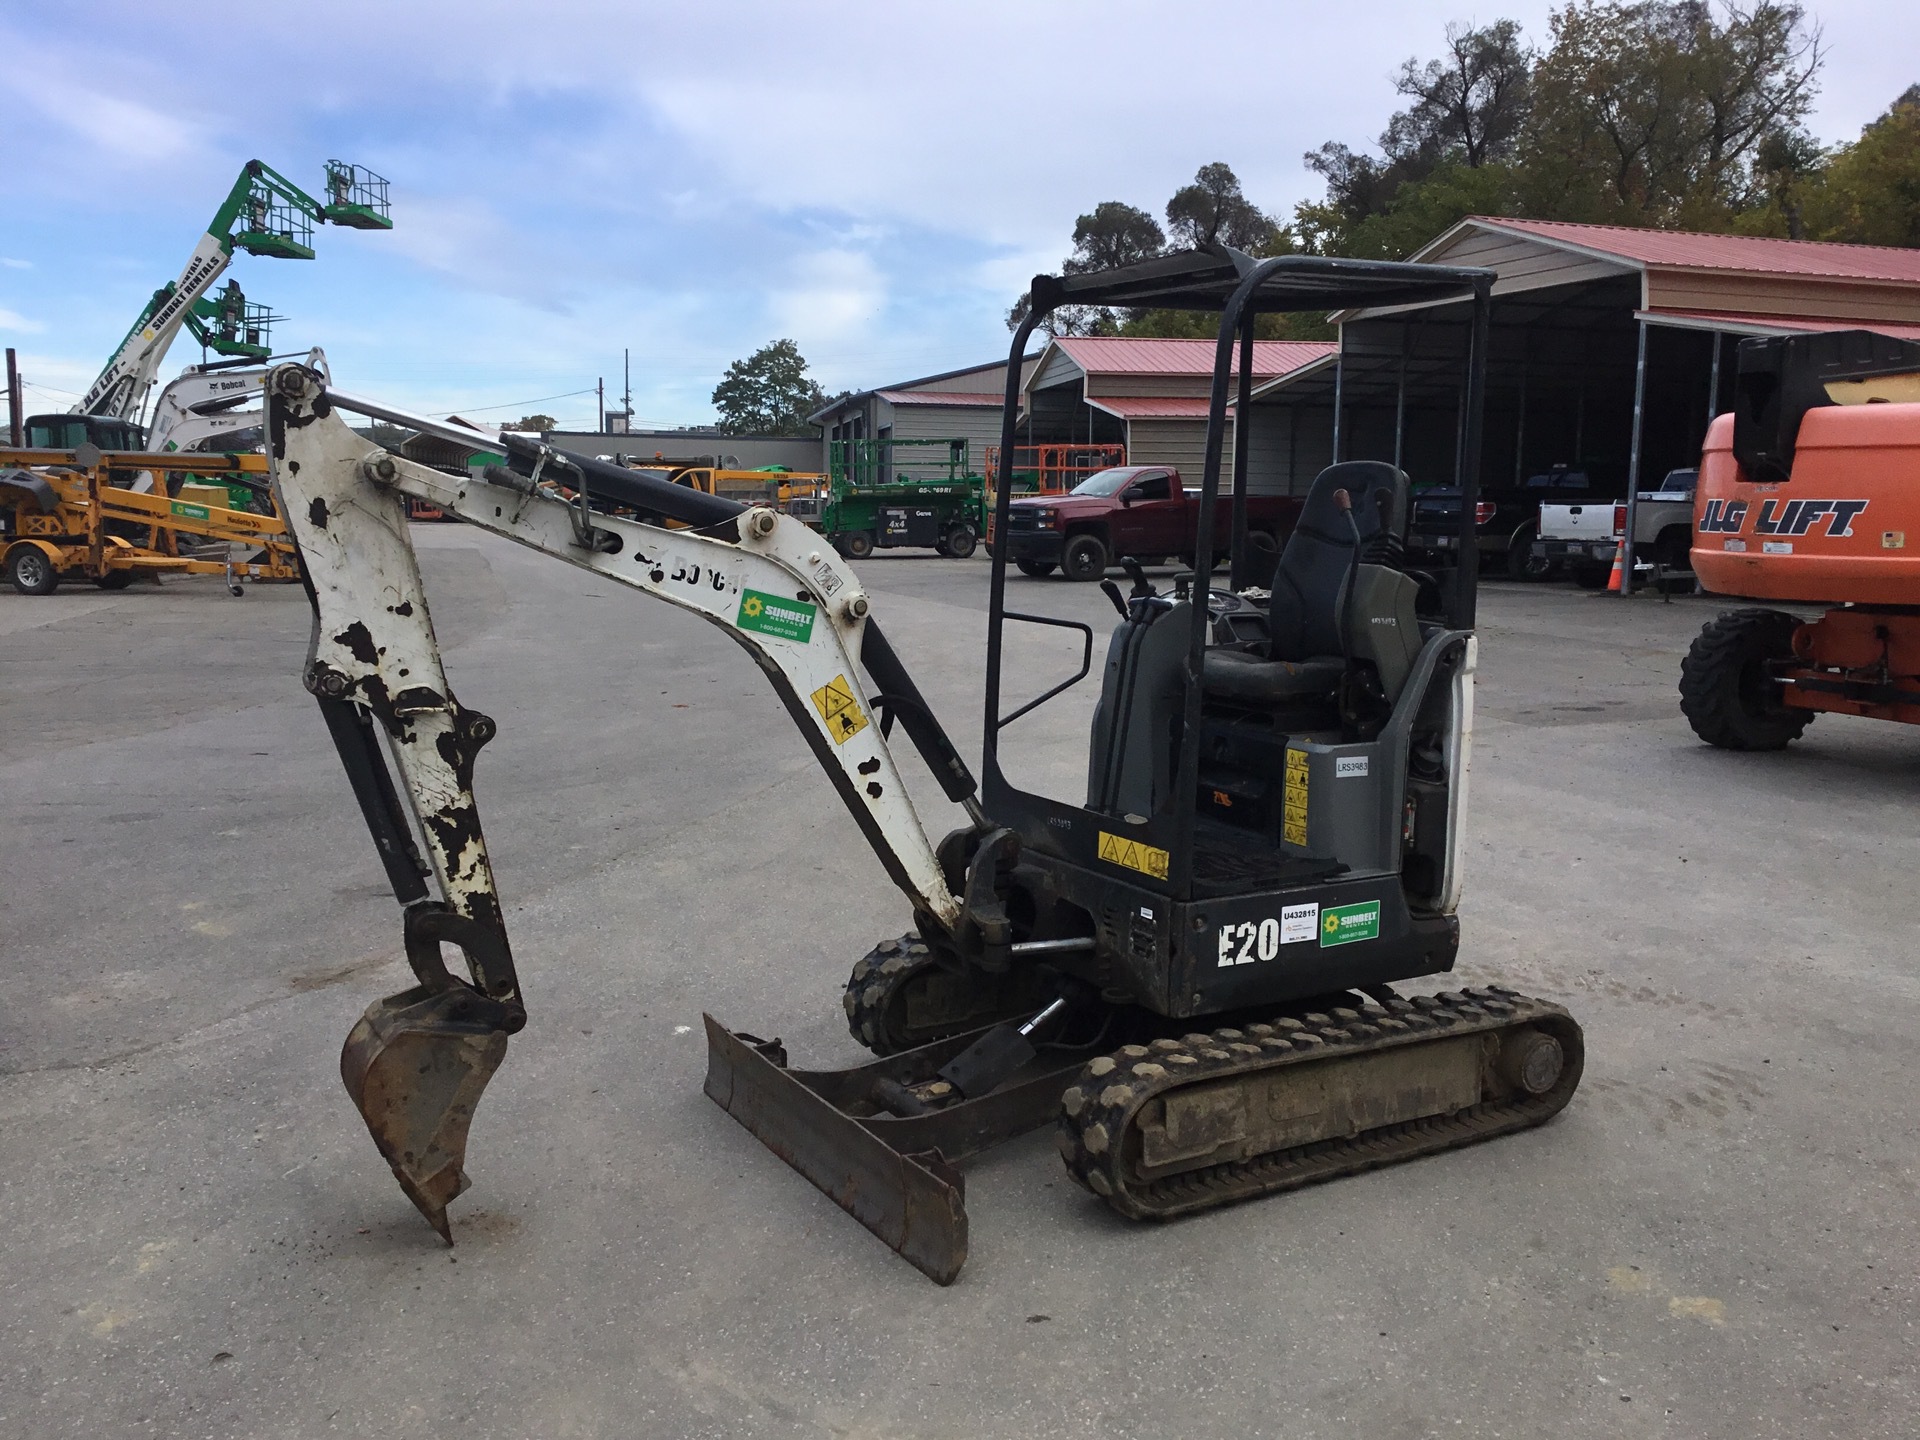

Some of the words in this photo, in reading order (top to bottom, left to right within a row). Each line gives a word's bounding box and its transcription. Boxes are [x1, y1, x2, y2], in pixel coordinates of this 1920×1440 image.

[84, 386, 101, 410] JLG
[99, 363, 121, 391] LIFT
[152, 291, 187, 331] SUNBELT
[183, 256, 220, 295] RENTALS
[220, 379, 246, 390] Bobcat
[888, 520, 905, 528] 4x4
[1699, 499, 1749, 534] JLG
[765, 604, 812, 625] SUNBELT
[770, 615, 804, 628] RENTALS
[1284, 909, 1316, 920] U432815
[1340, 911, 1377, 926] SUNBELT
[1218, 918, 1279, 967] E20
